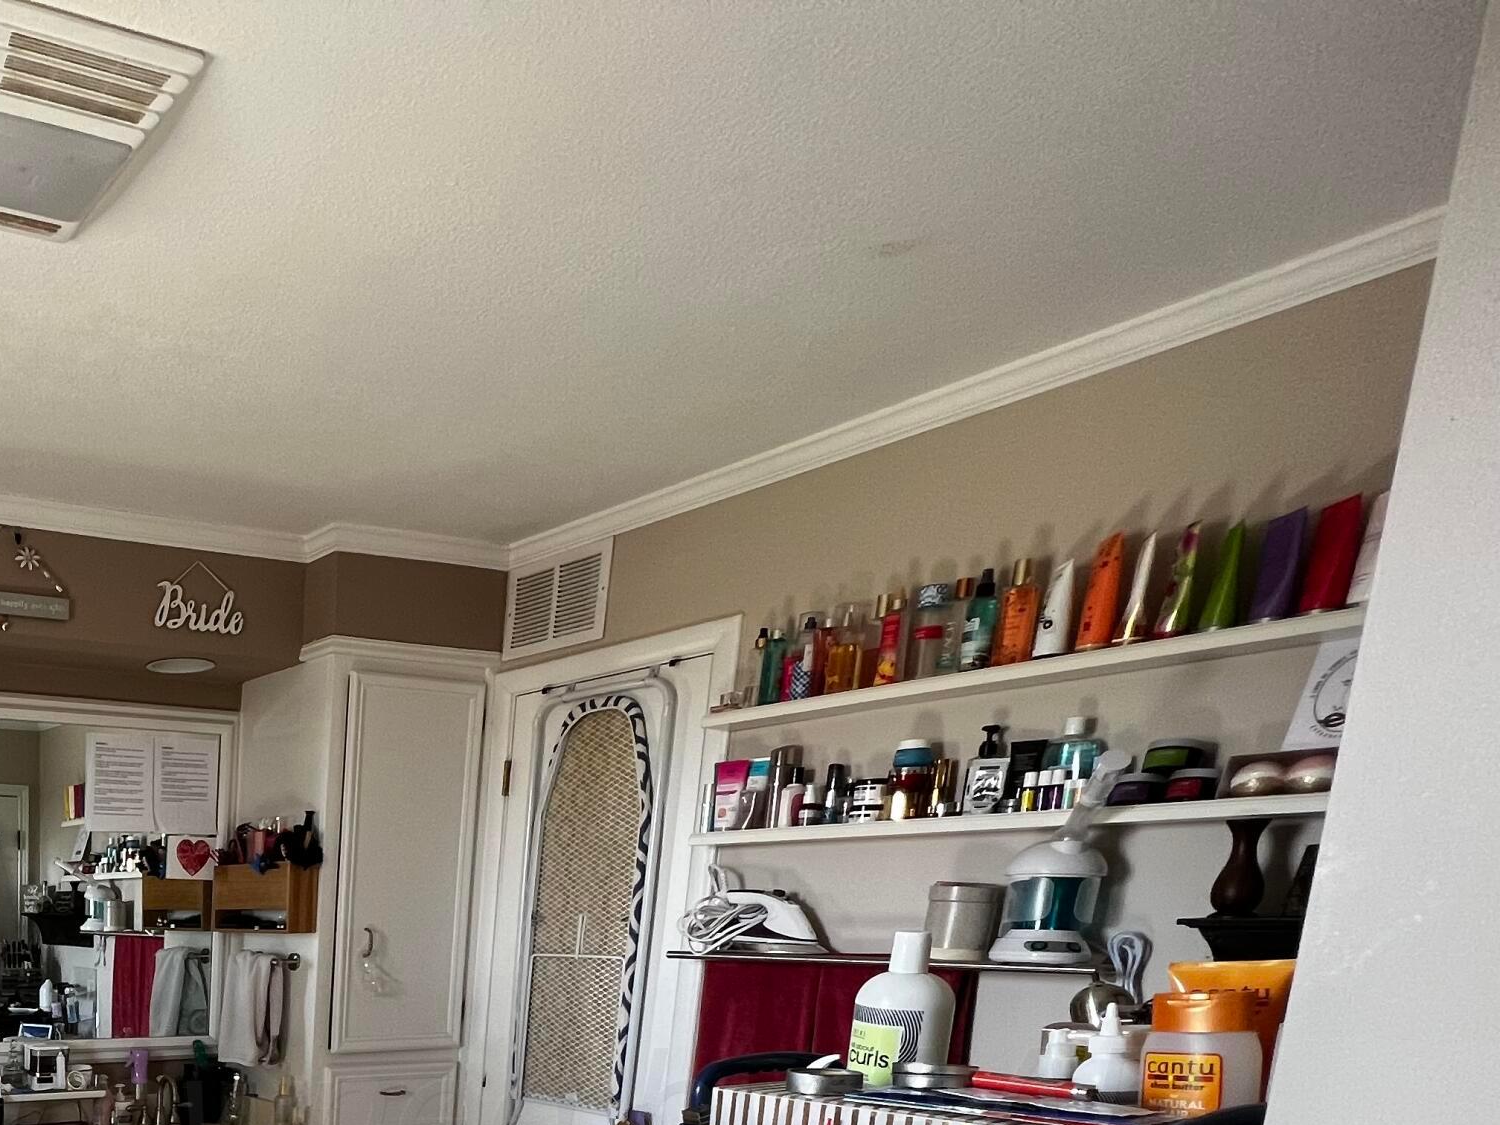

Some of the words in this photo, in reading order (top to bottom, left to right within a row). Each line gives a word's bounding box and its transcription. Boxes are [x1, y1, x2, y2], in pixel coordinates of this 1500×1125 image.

[153, 580, 244, 635] Bride
[849, 1049, 890, 1069] curls
[1147, 1059, 1215, 1076] cantu
